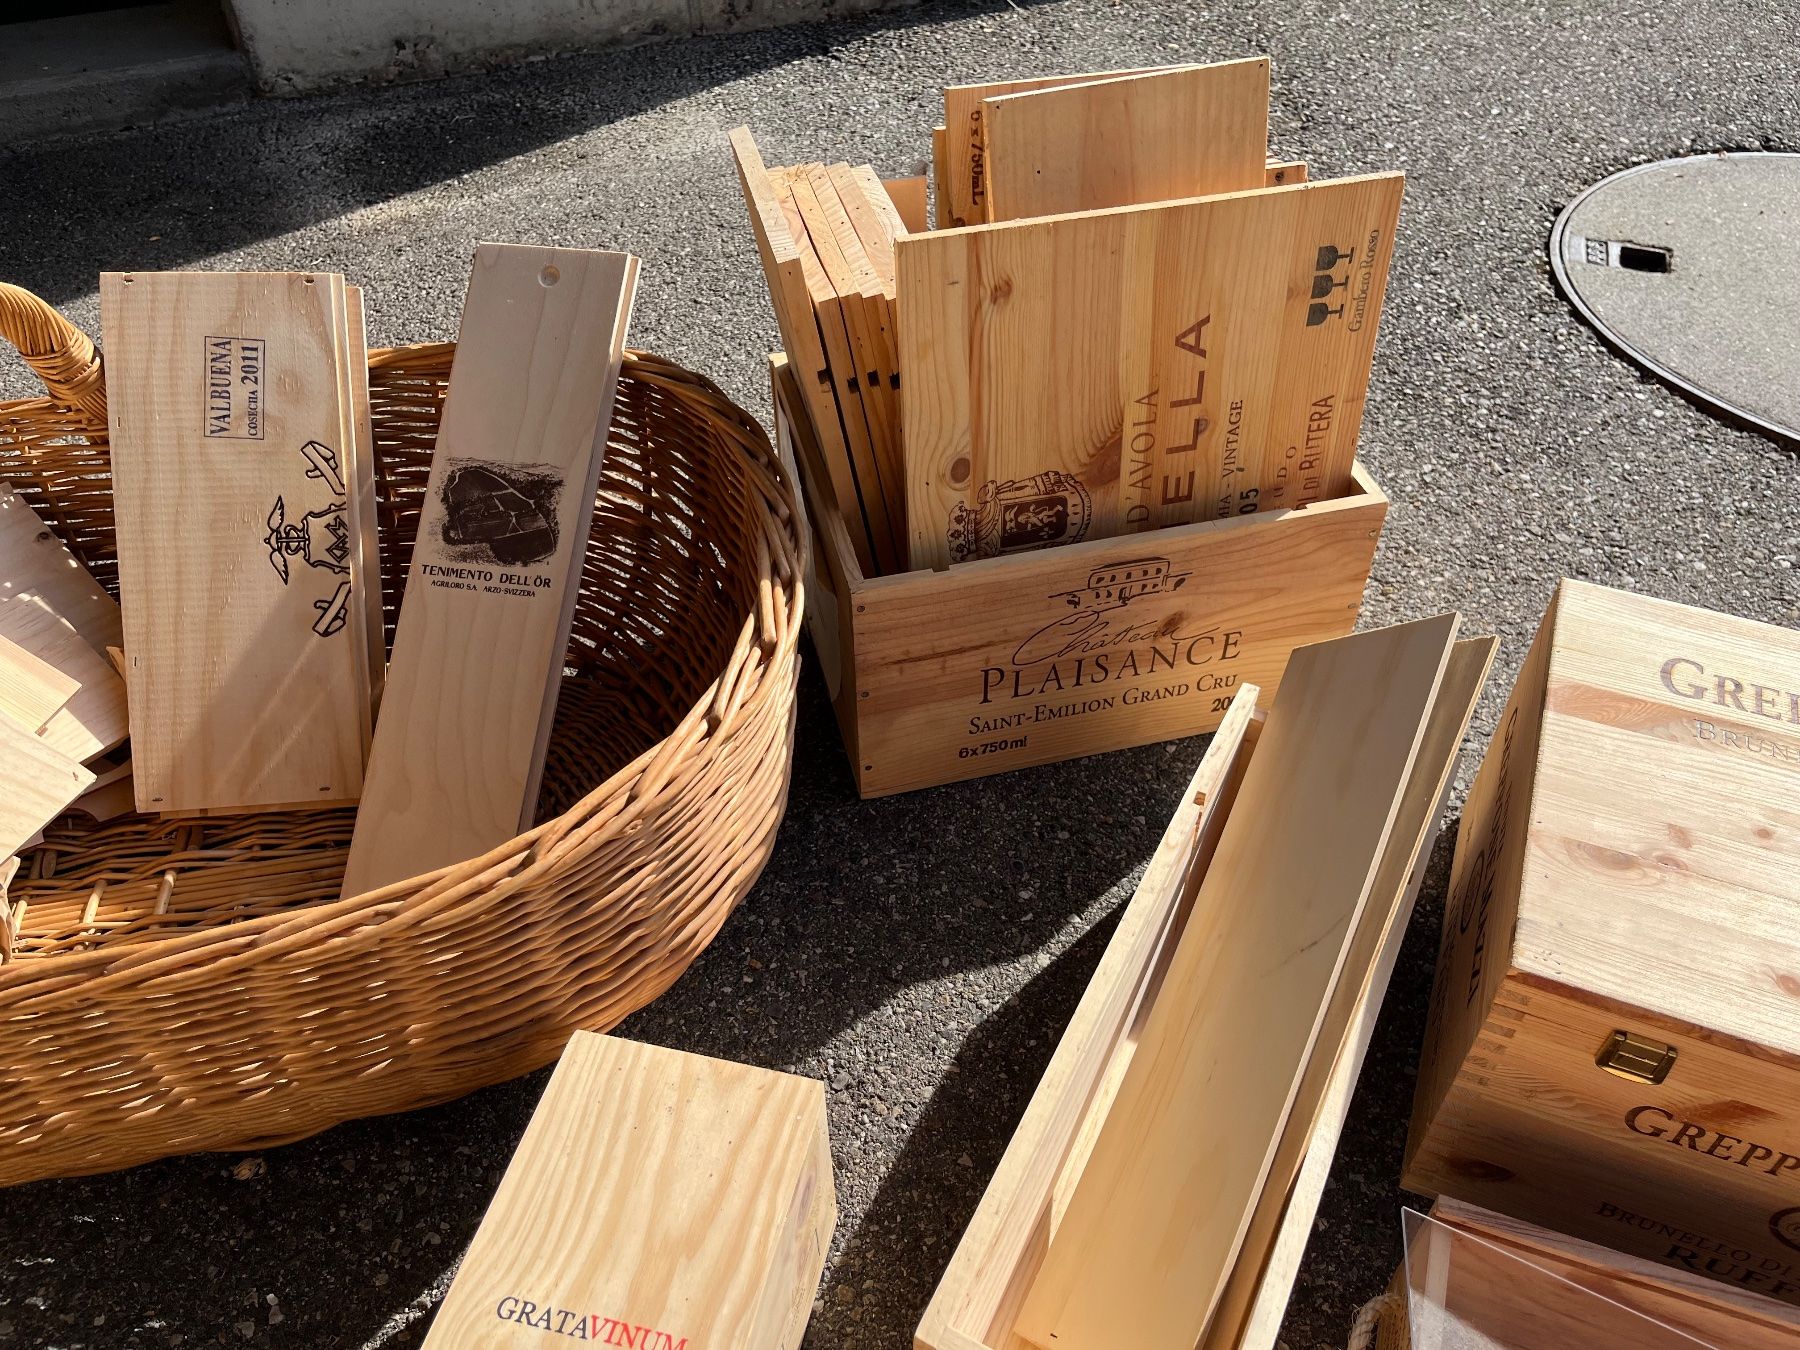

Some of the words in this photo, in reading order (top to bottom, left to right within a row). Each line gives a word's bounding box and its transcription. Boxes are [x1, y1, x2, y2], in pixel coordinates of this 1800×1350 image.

[1348, 271, 1372, 333] Gambero
[1360, 229, 1380, 270] Rosso
[209, 340, 232, 435] VALBUENA
[240, 346, 259, 386] 2011
[247, 389, 258, 436] COSECHA
[1222, 400, 1244, 479] VINTAGE
[1126, 387, 1159, 524] D'AVOLA
[421, 564, 493, 582] TENIMENTO
[430, 580, 465, 589] AGRILORO
[978, 631, 1243, 705] PLAISANCE
[968, 695, 1116, 736] SAINT-EMILION
[1122, 683, 1190, 707] GRAND
[1196, 673, 1238, 692] CRU
[1594, 1201, 1752, 1262] BRUNELLO
